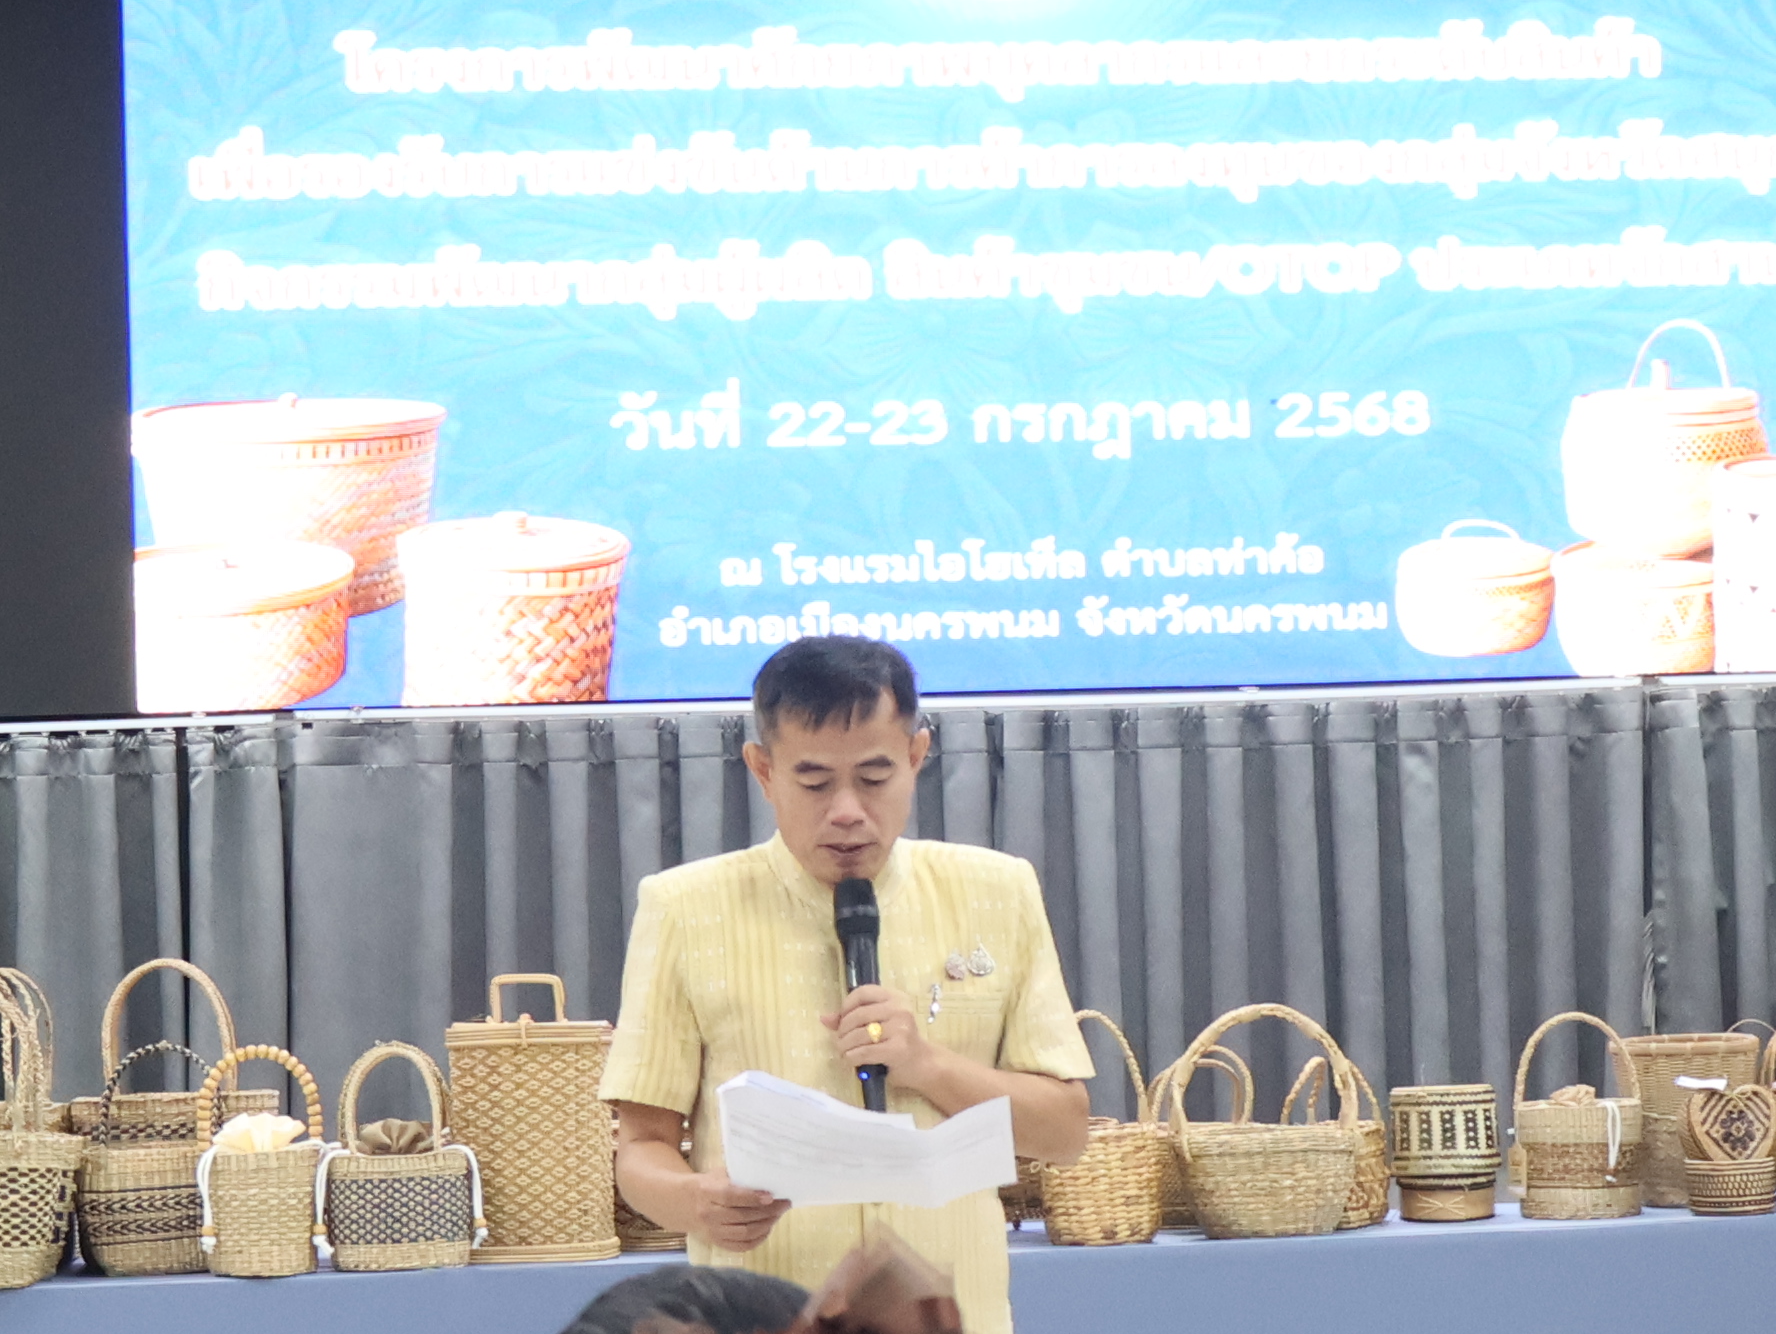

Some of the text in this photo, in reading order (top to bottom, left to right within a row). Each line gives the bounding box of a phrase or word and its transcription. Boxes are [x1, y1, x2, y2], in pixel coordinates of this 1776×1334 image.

[609, 376, 1432, 460] วันที่ 22-23 กรกฎาคม 2568
[719, 556, 763, 587] ณ
[1101, 531, 1325, 579] ตำบลท่าค้อ
[658, 593, 1389, 647] อำเภอเมืองนครพนม จังหวัดนครพนม
